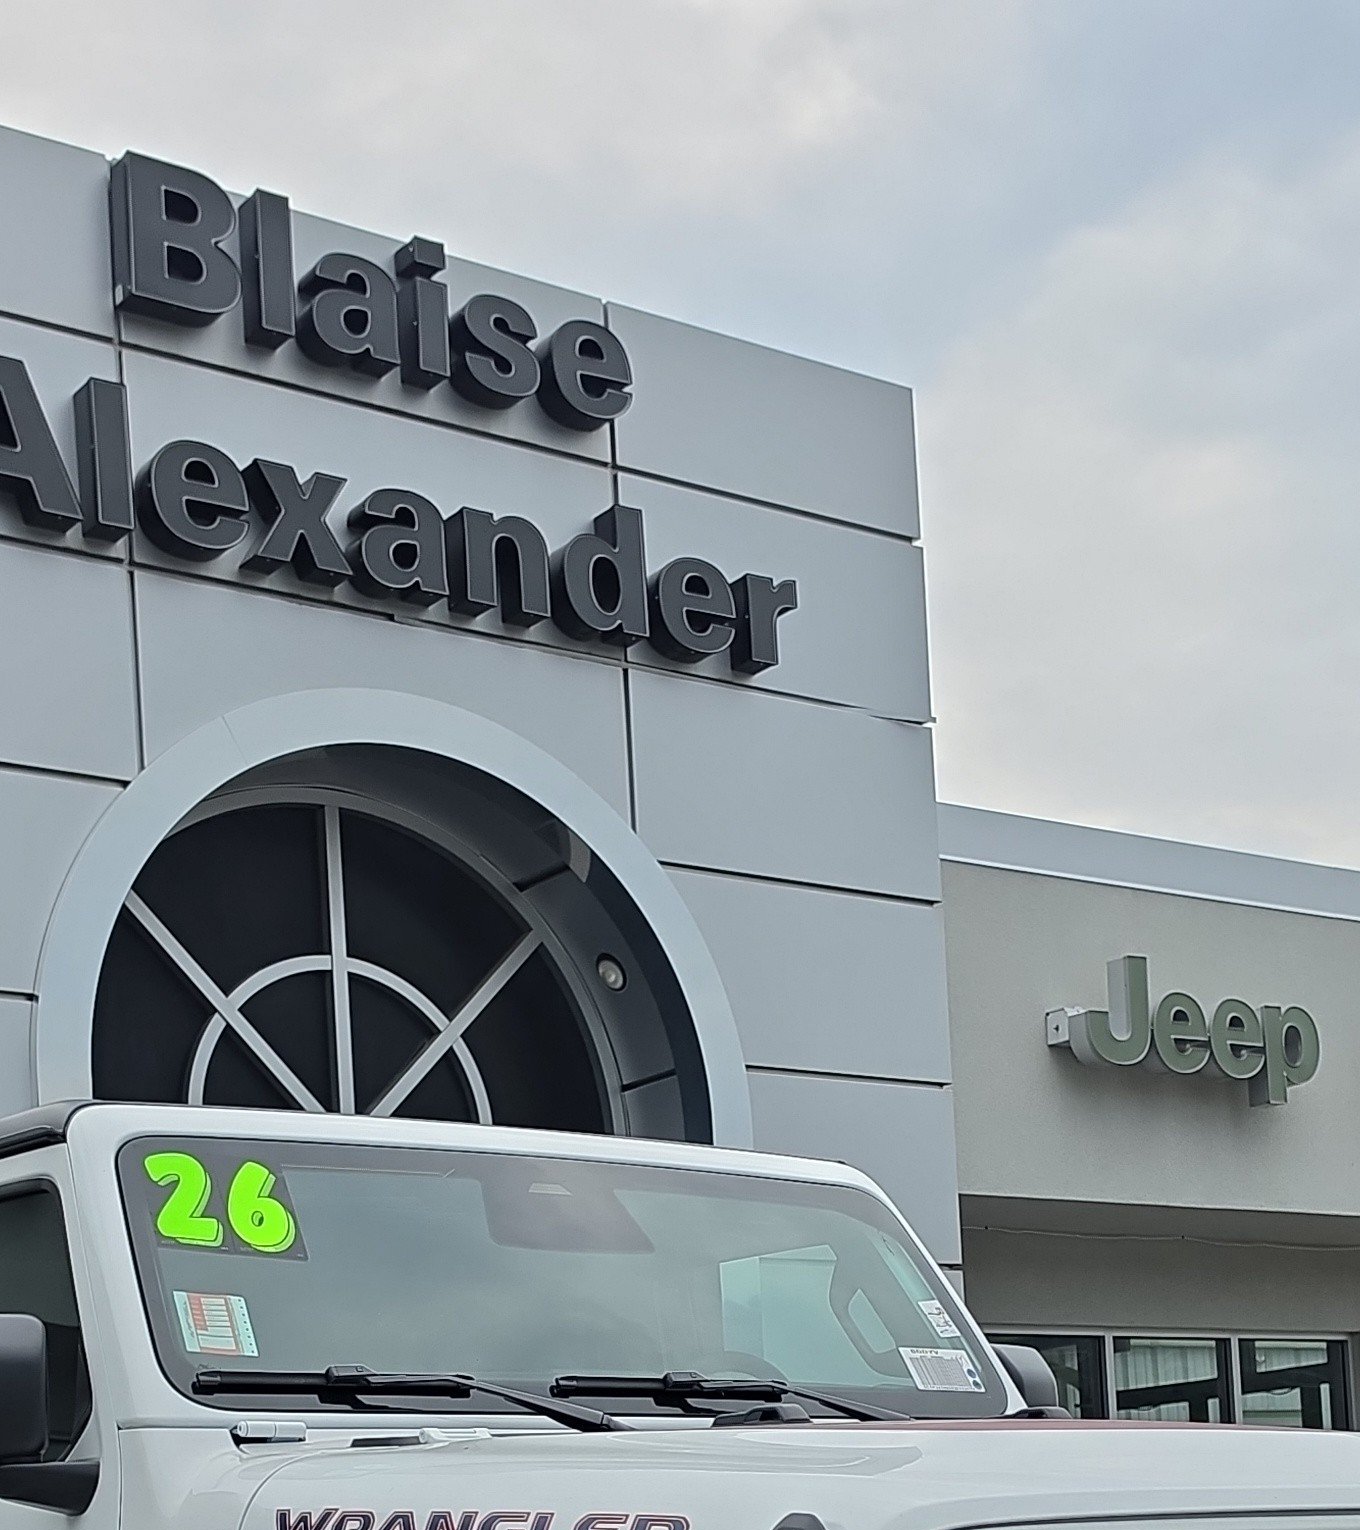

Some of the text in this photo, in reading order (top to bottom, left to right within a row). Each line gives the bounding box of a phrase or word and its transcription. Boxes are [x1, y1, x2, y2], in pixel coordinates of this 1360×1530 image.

[110, 150, 634, 431] Blaise
[1068, 954, 1321, 1106] Jeep
[143, 1151, 296, 1253] 26
